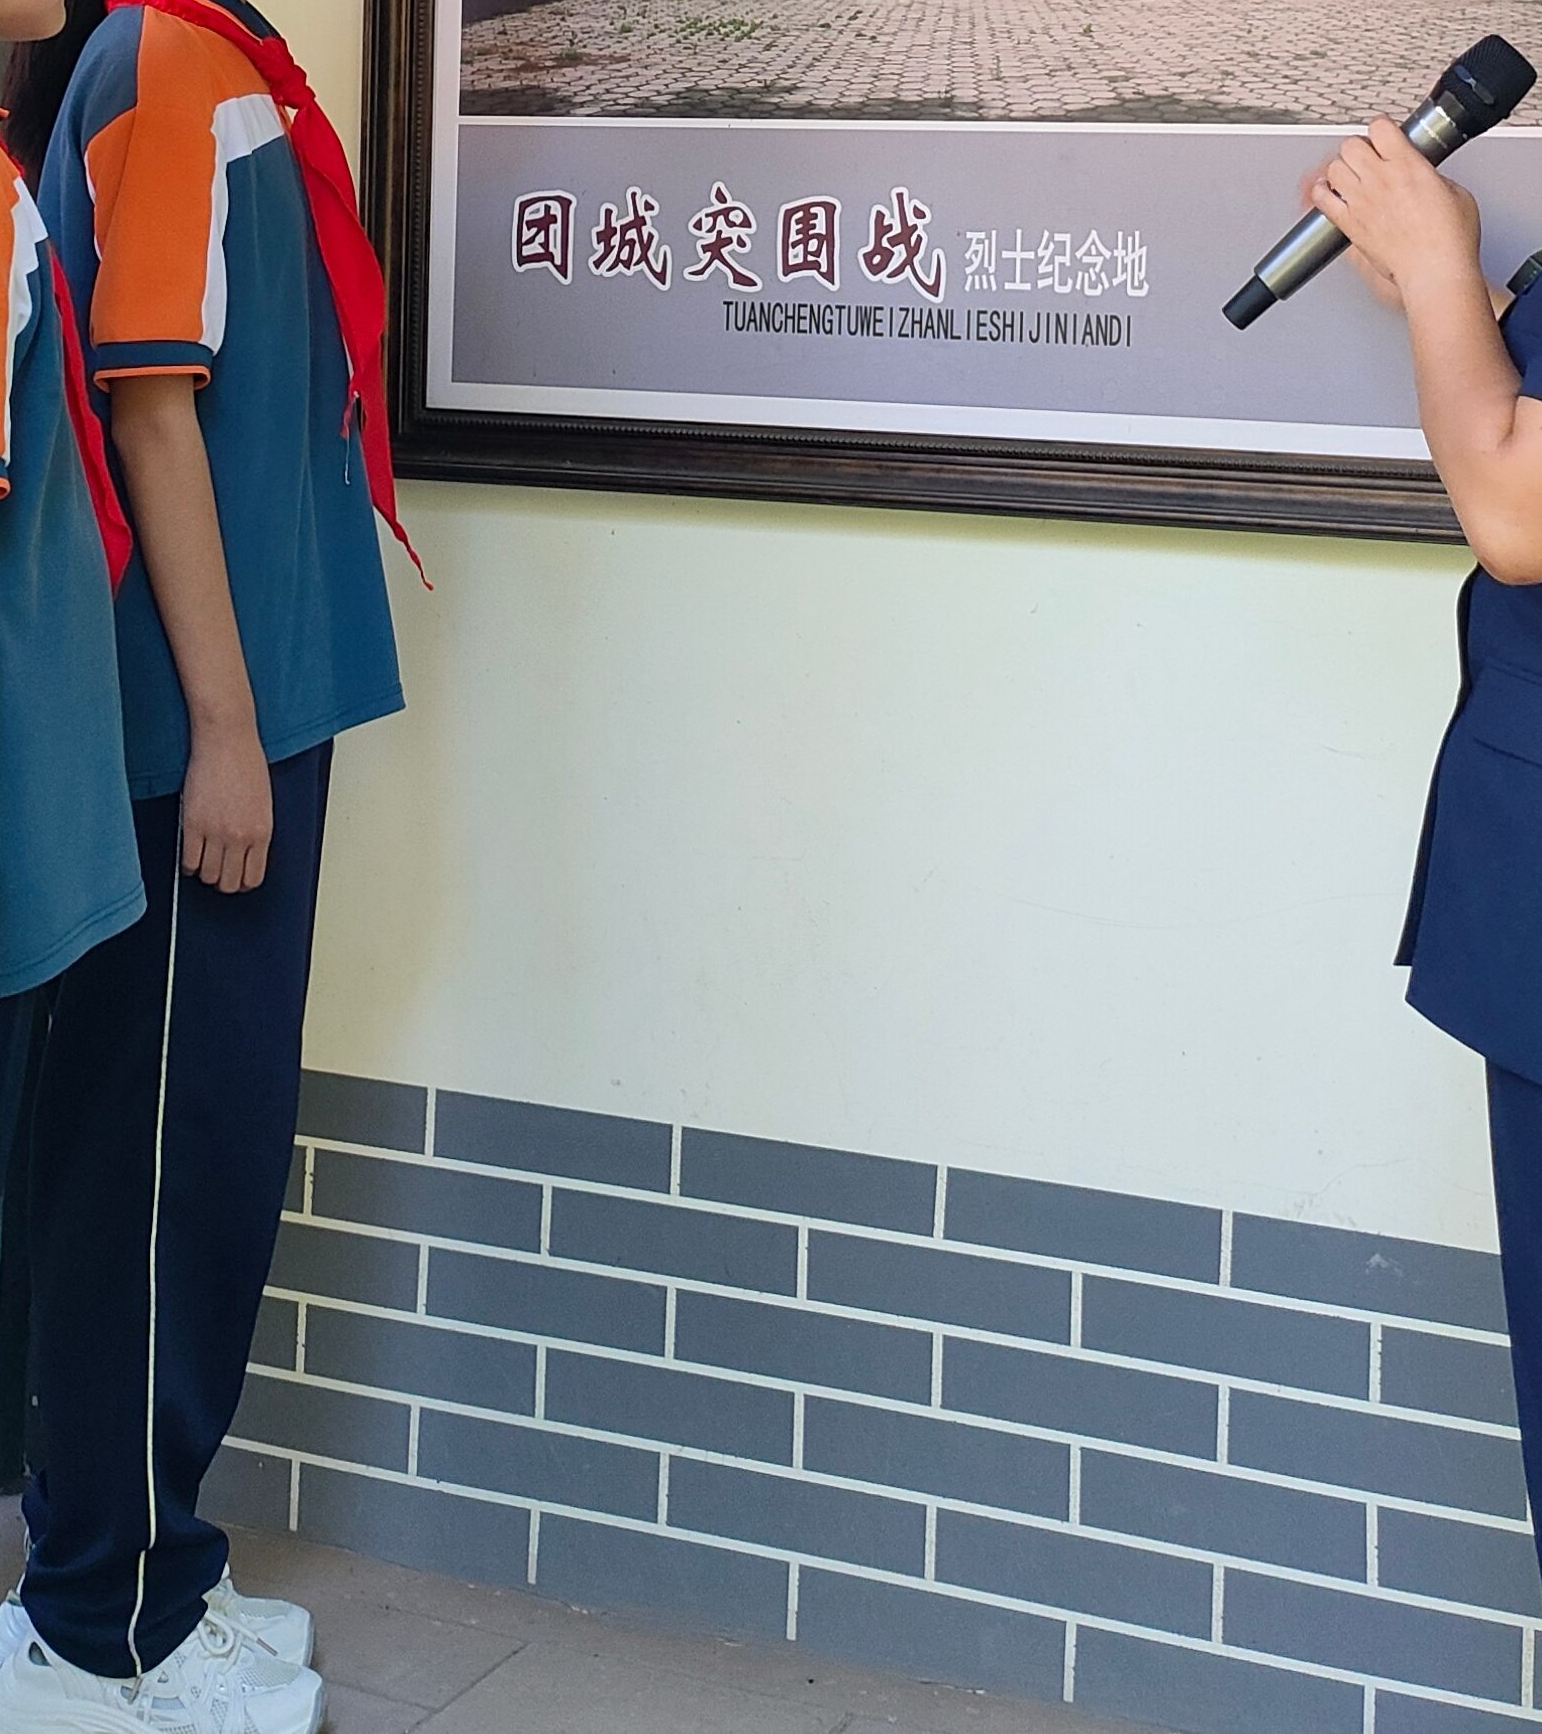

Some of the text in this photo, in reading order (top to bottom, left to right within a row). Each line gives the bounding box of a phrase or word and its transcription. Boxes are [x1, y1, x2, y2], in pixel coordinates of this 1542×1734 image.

[511, 180, 1150, 304] 团城突围战 烈士纪念地
[722, 299, 1133, 349] TUANCHENGTUWEIZHANLIESHIJINIANDI
